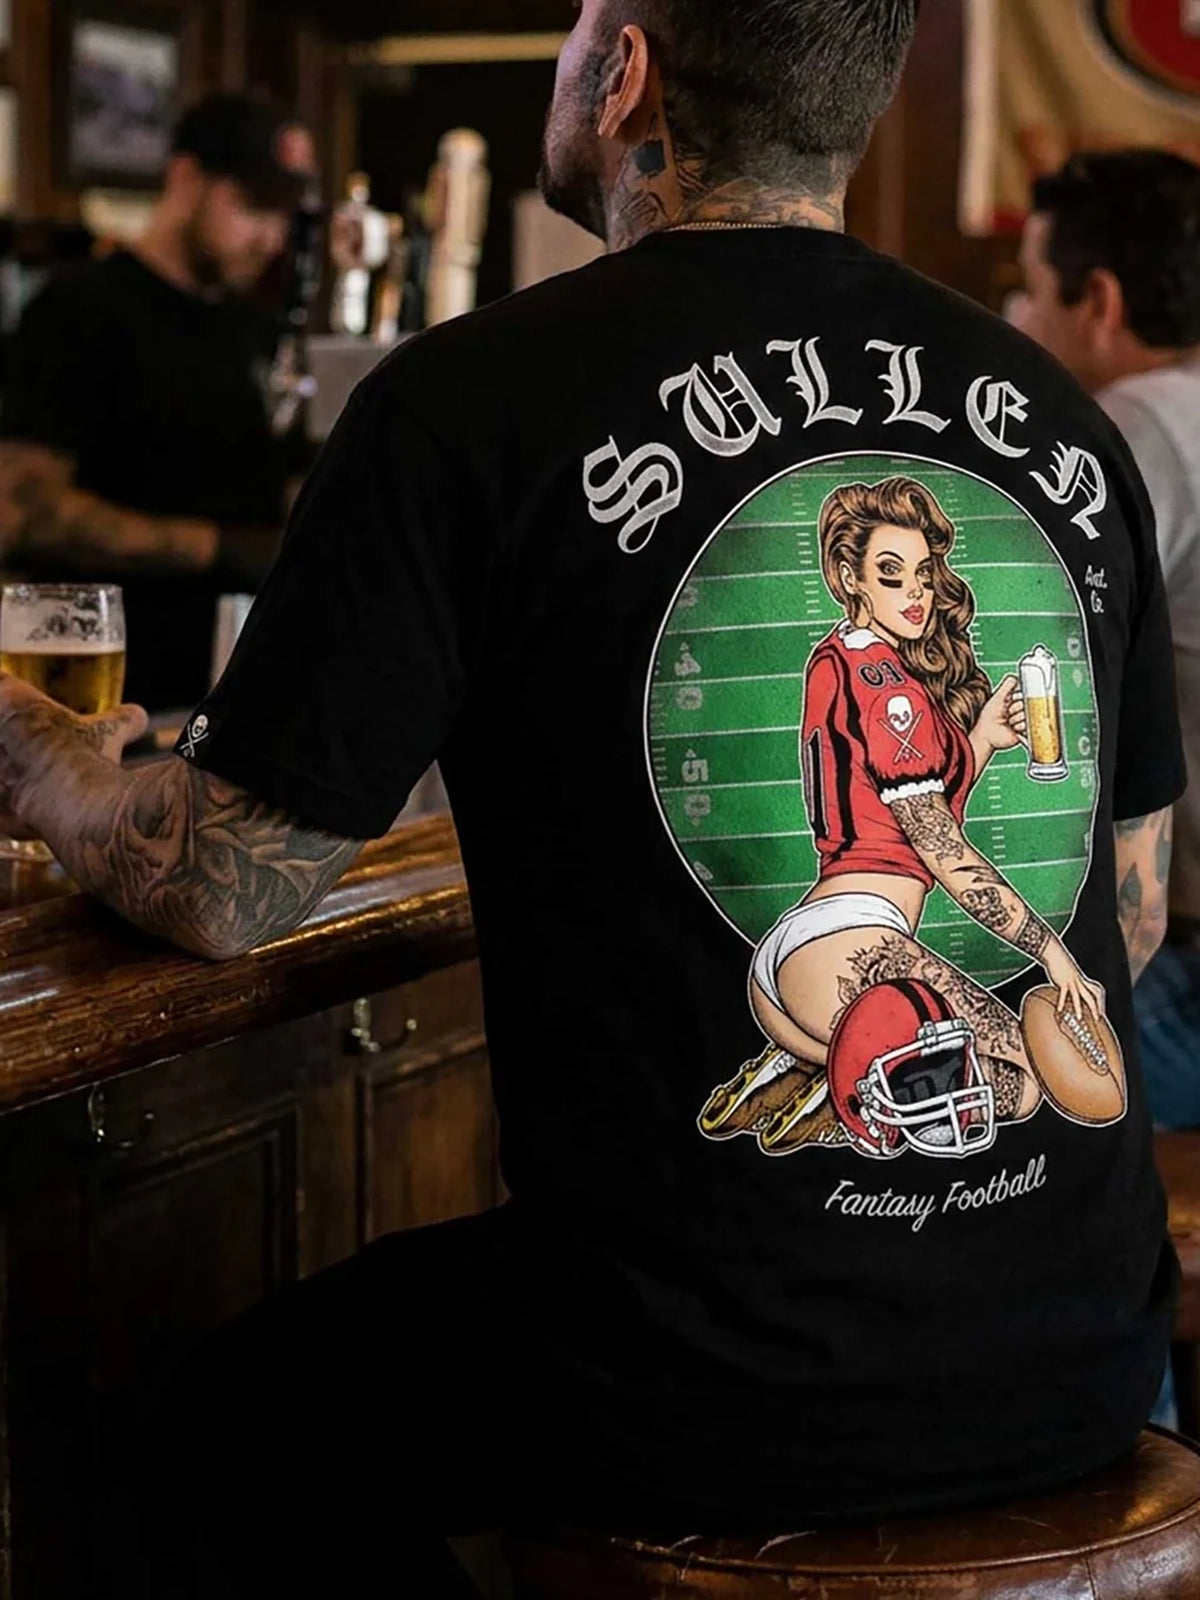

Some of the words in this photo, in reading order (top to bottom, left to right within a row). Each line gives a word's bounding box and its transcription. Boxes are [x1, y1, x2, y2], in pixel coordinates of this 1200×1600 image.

[583, 336, 1107, 554] SULLEN
[825, 1180, 936, 1233] Fantasy
[942, 1153, 1047, 1214] Football
